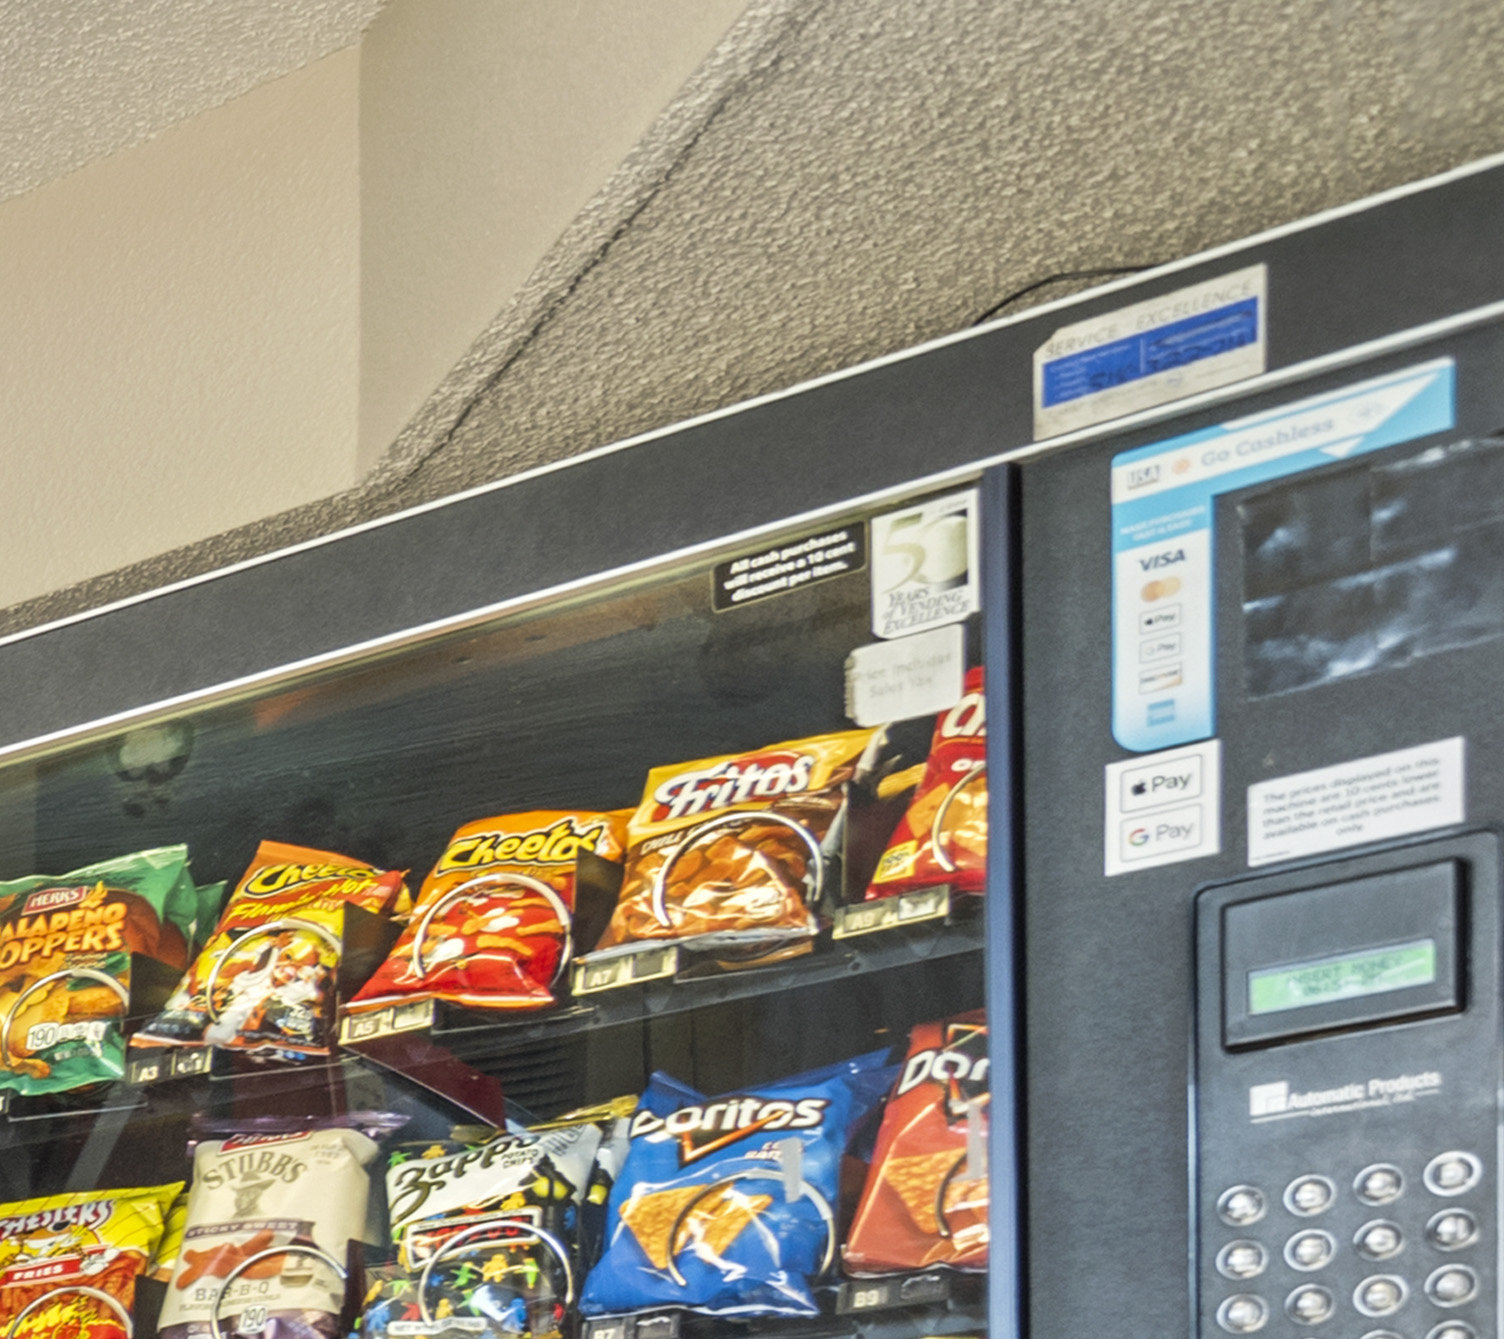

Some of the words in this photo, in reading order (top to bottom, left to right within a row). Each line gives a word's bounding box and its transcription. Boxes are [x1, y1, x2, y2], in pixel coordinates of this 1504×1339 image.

[1139, 548, 1186, 571] VISA
[654, 754, 816, 824] Fritos
[1150, 770, 1192, 796] Pay
[1289, 1083, 1365, 1109] Automatic
[1367, 1071, 1442, 1097] Products
[630, 1096, 828, 1140] Doritos
[13, 1263, 64, 1281] FRIES
